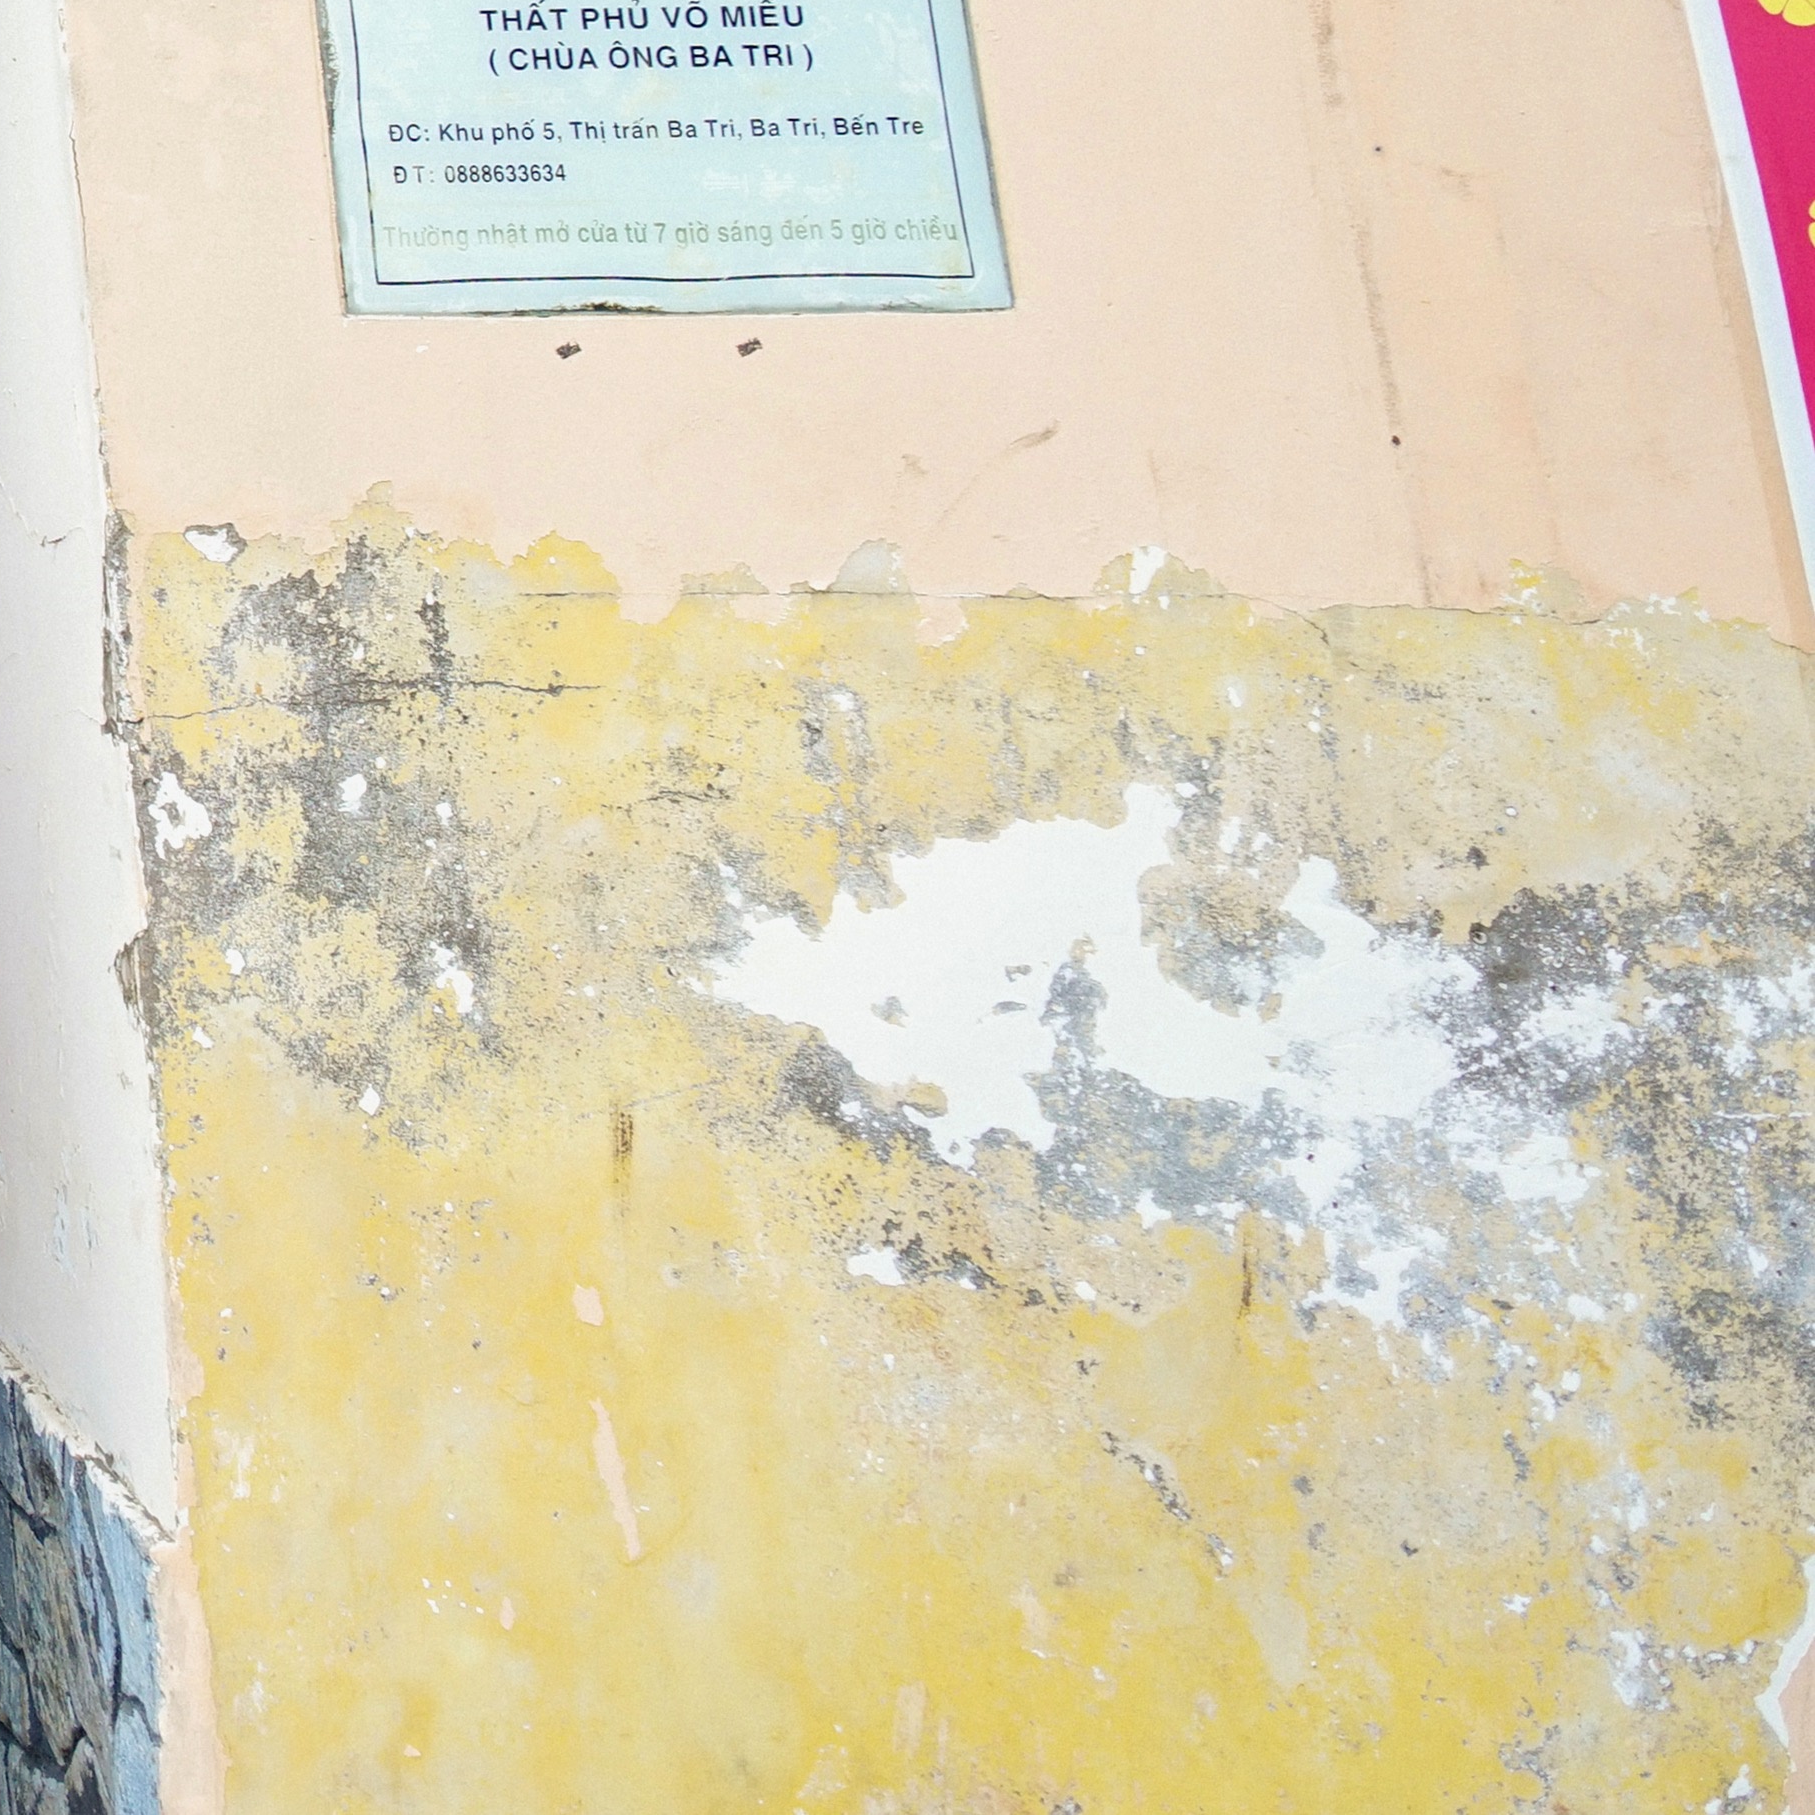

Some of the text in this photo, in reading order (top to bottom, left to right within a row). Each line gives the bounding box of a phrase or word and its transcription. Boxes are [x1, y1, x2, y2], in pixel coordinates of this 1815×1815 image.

[479, 0, 568, 31] THẤT
[661, 0, 708, 29] VÕ
[609, 40, 679, 69] ÔNG
[690, 45, 733, 68] BA
[388, 114, 926, 145] ĐC: Khu phố 5, Thị trấn Ba Tri, Ba Tri, Bến Tre
[444, 164, 567, 183] 0888633634
[383, 215, 958, 252] Thường nhật mở cửa từ 7 giờ sáng đến 5 giờ chiều
